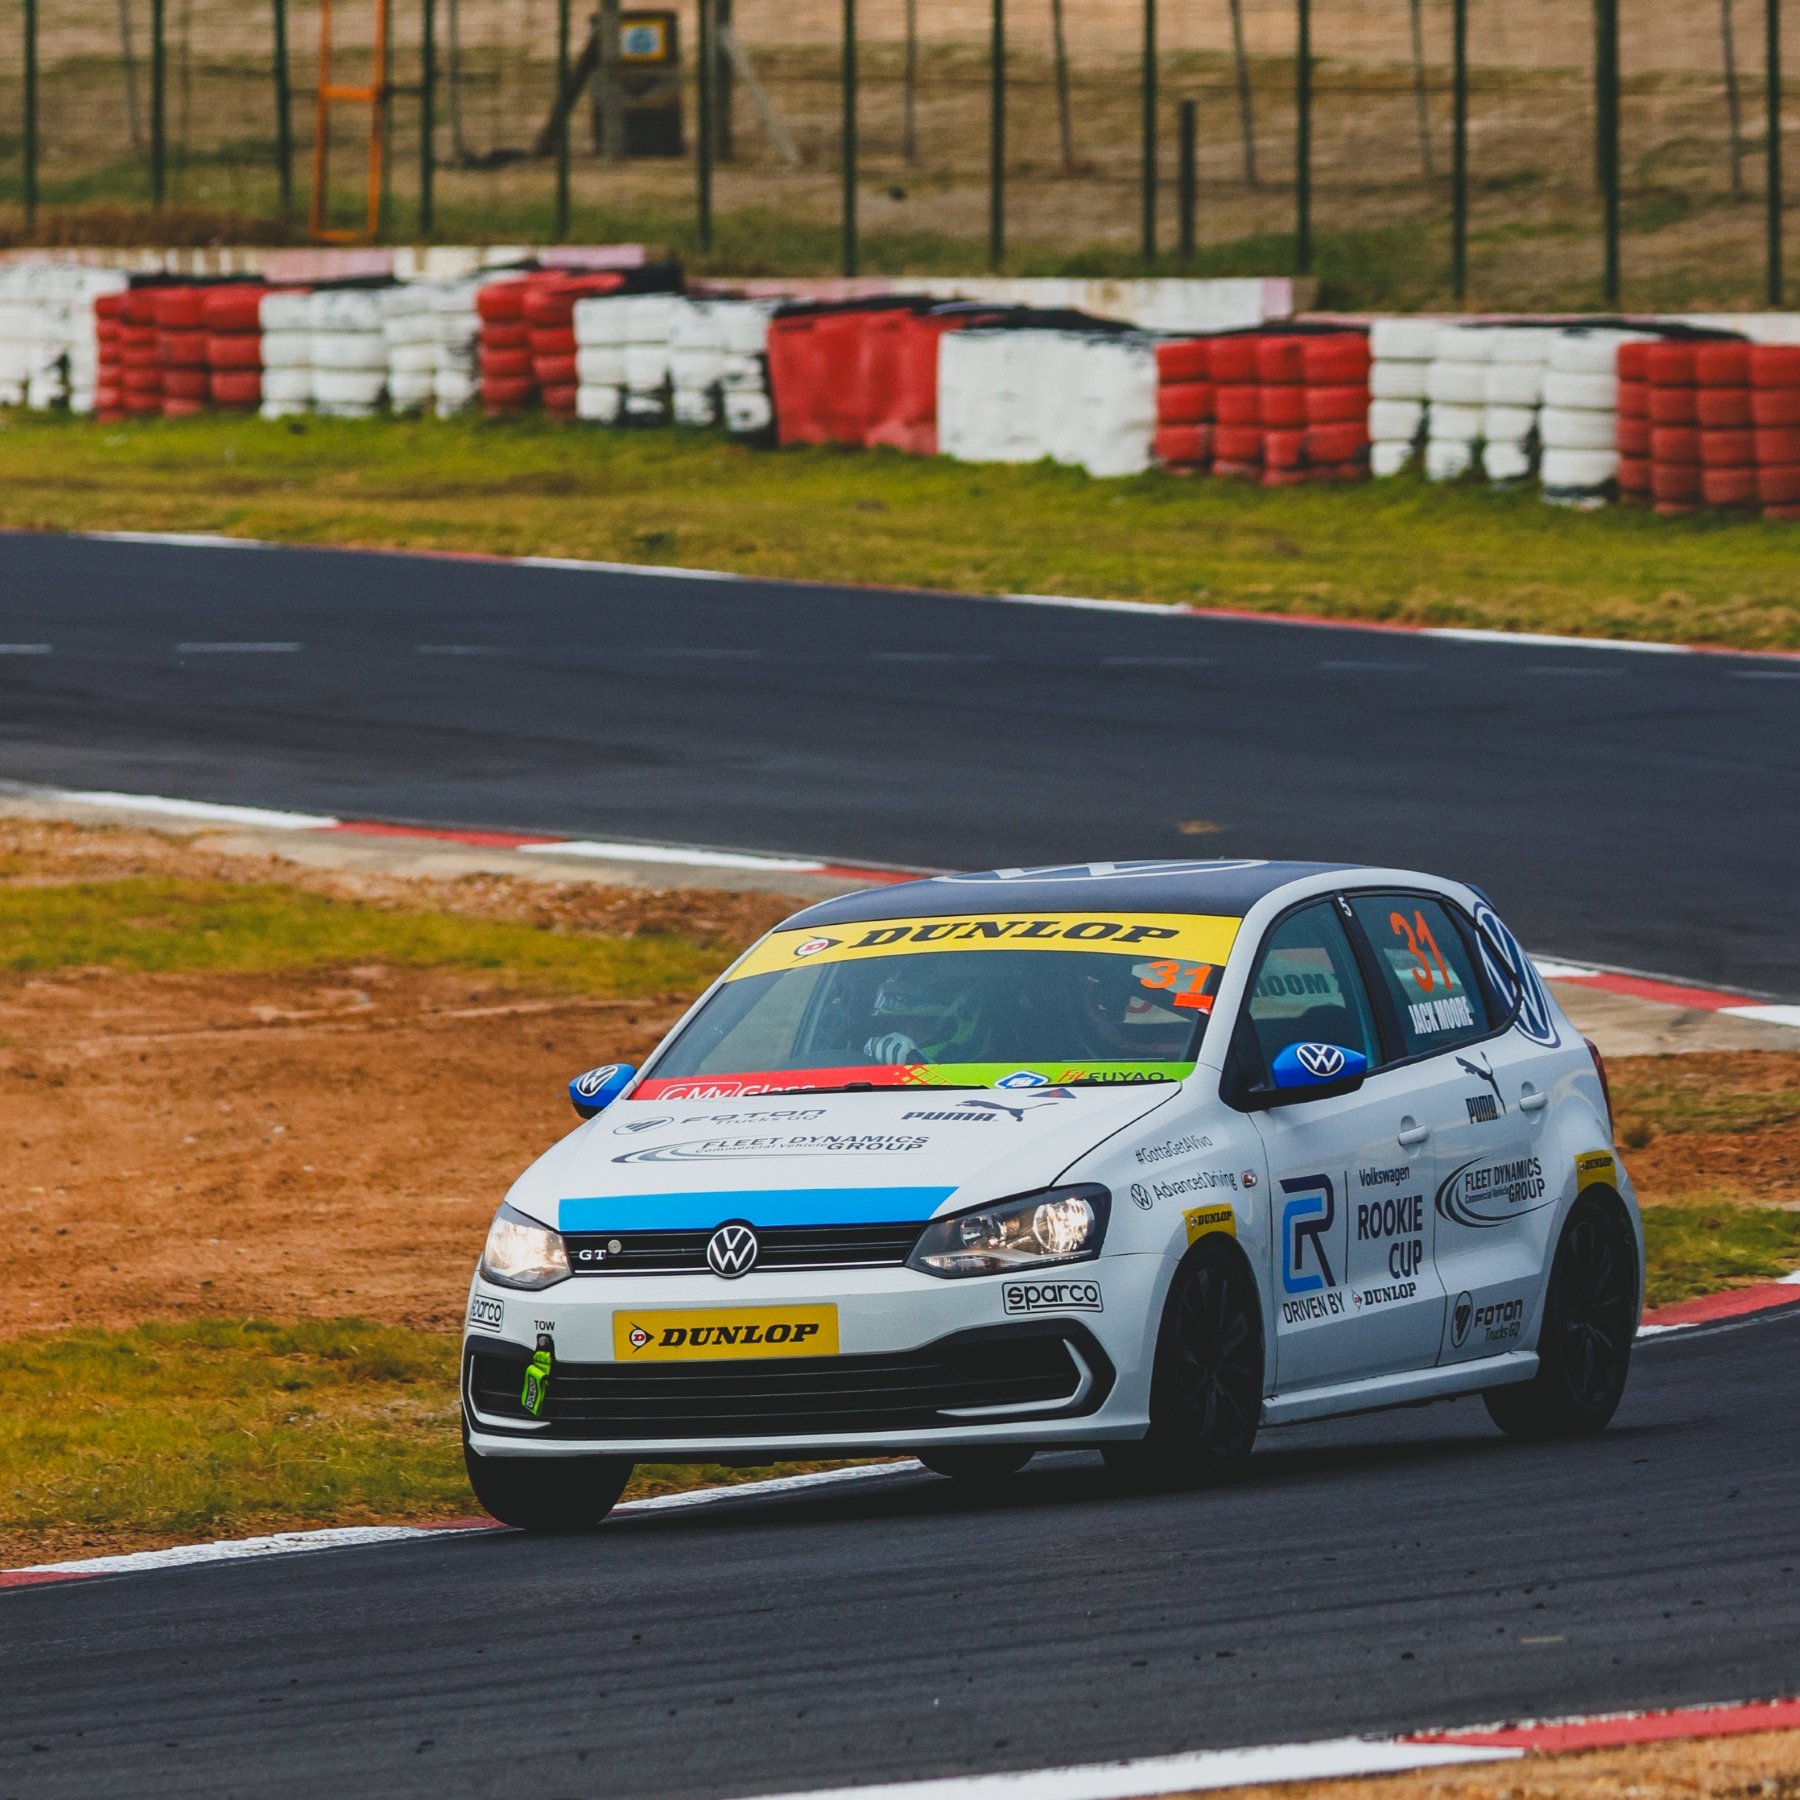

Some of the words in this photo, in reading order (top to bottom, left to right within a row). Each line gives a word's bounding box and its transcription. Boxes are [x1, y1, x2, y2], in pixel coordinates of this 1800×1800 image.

[1338, 897, 1352, 917] 5
[848, 920, 1181, 949] DUNLOP
[1389, 910, 1453, 993] 31
[1140, 961, 1212, 994] 31
[1408, 1000, 1440, 1035] JACK
[1434, 996, 1474, 1031] MOORE
[681, 1109, 827, 1124] FOTON
[901, 1111, 998, 1122] PUMA
[1465, 1094, 1499, 1124] PUMA
[702, 1137, 783, 1149] FLEET
[789, 1135, 930, 1144] DYNAMICS
[827, 1143, 924, 1151] GROUP
[1136, 1135, 1213, 1165] #GottaGetAVivo
[1152, 1172, 1206, 1200] Advanced
[1203, 1170, 1238, 1191] Driving
[1359, 1166, 1410, 1187] Volkswagen
[1465, 1168, 1493, 1192] FLEET
[1494, 1157, 1542, 1185] DYNAMICS
[1508, 1178, 1545, 1203] GROUP
[1197, 1211, 1232, 1225] DUNLOP
[1358, 1195, 1423, 1240] ROOKIE
[1389, 1240, 1422, 1279] CUP
[470, 1299, 502, 1323] parco
[1007, 1285, 1098, 1311] sparco
[1283, 1296, 1329, 1324] DRIVEN
[1327, 1291, 1346, 1315] BY
[1363, 1282, 1417, 1306] DUNLOP
[534, 1320, 555, 1331] TOW
[1474, 1299, 1523, 1328] FOTON
[658, 1324, 819, 1347] DUNLOP
